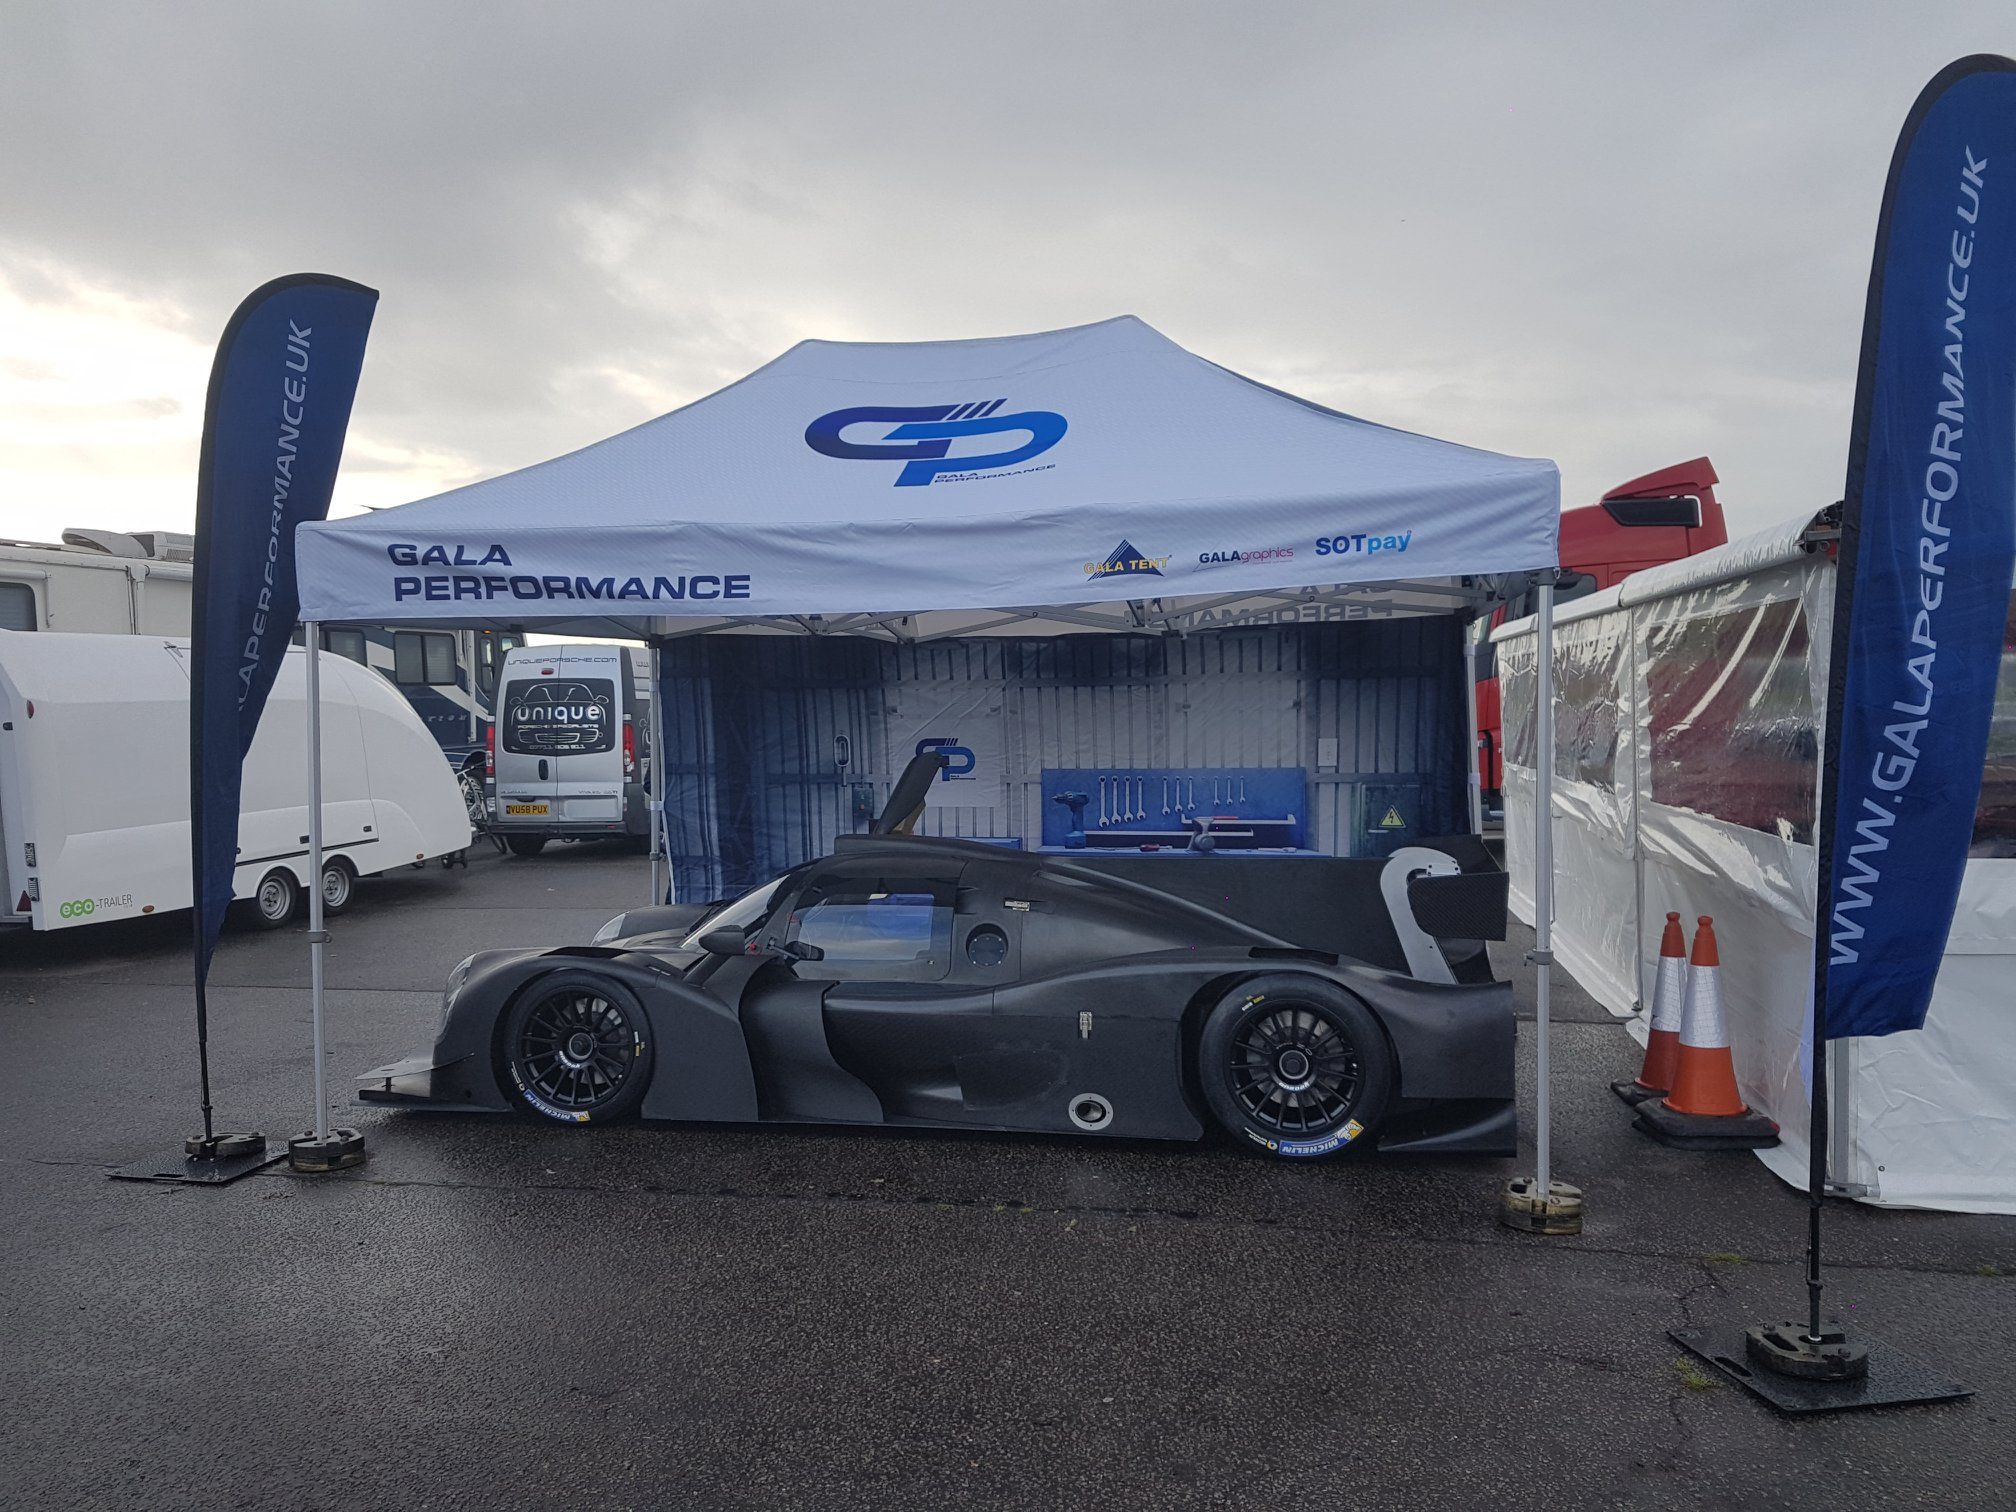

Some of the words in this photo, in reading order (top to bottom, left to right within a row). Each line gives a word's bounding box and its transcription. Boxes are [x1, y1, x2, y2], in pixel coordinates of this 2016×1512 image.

[1315, 531, 1411, 556] SOTpay
[387, 544, 512, 566] GALA
[1084, 561, 1124, 574] GALA
[1129, 556, 1168, 571] TENT
[1830, 145, 1988, 966] WWW.GALAPERFORMANCE.UK
[394, 575, 751, 601] PERFORMANCE
[517, 706, 600, 723] unique
[532, 805, 548, 814] PUX
[524, 1091, 571, 1120] MICHELIN
[1281, 1138, 1339, 1154] MICHELIN
